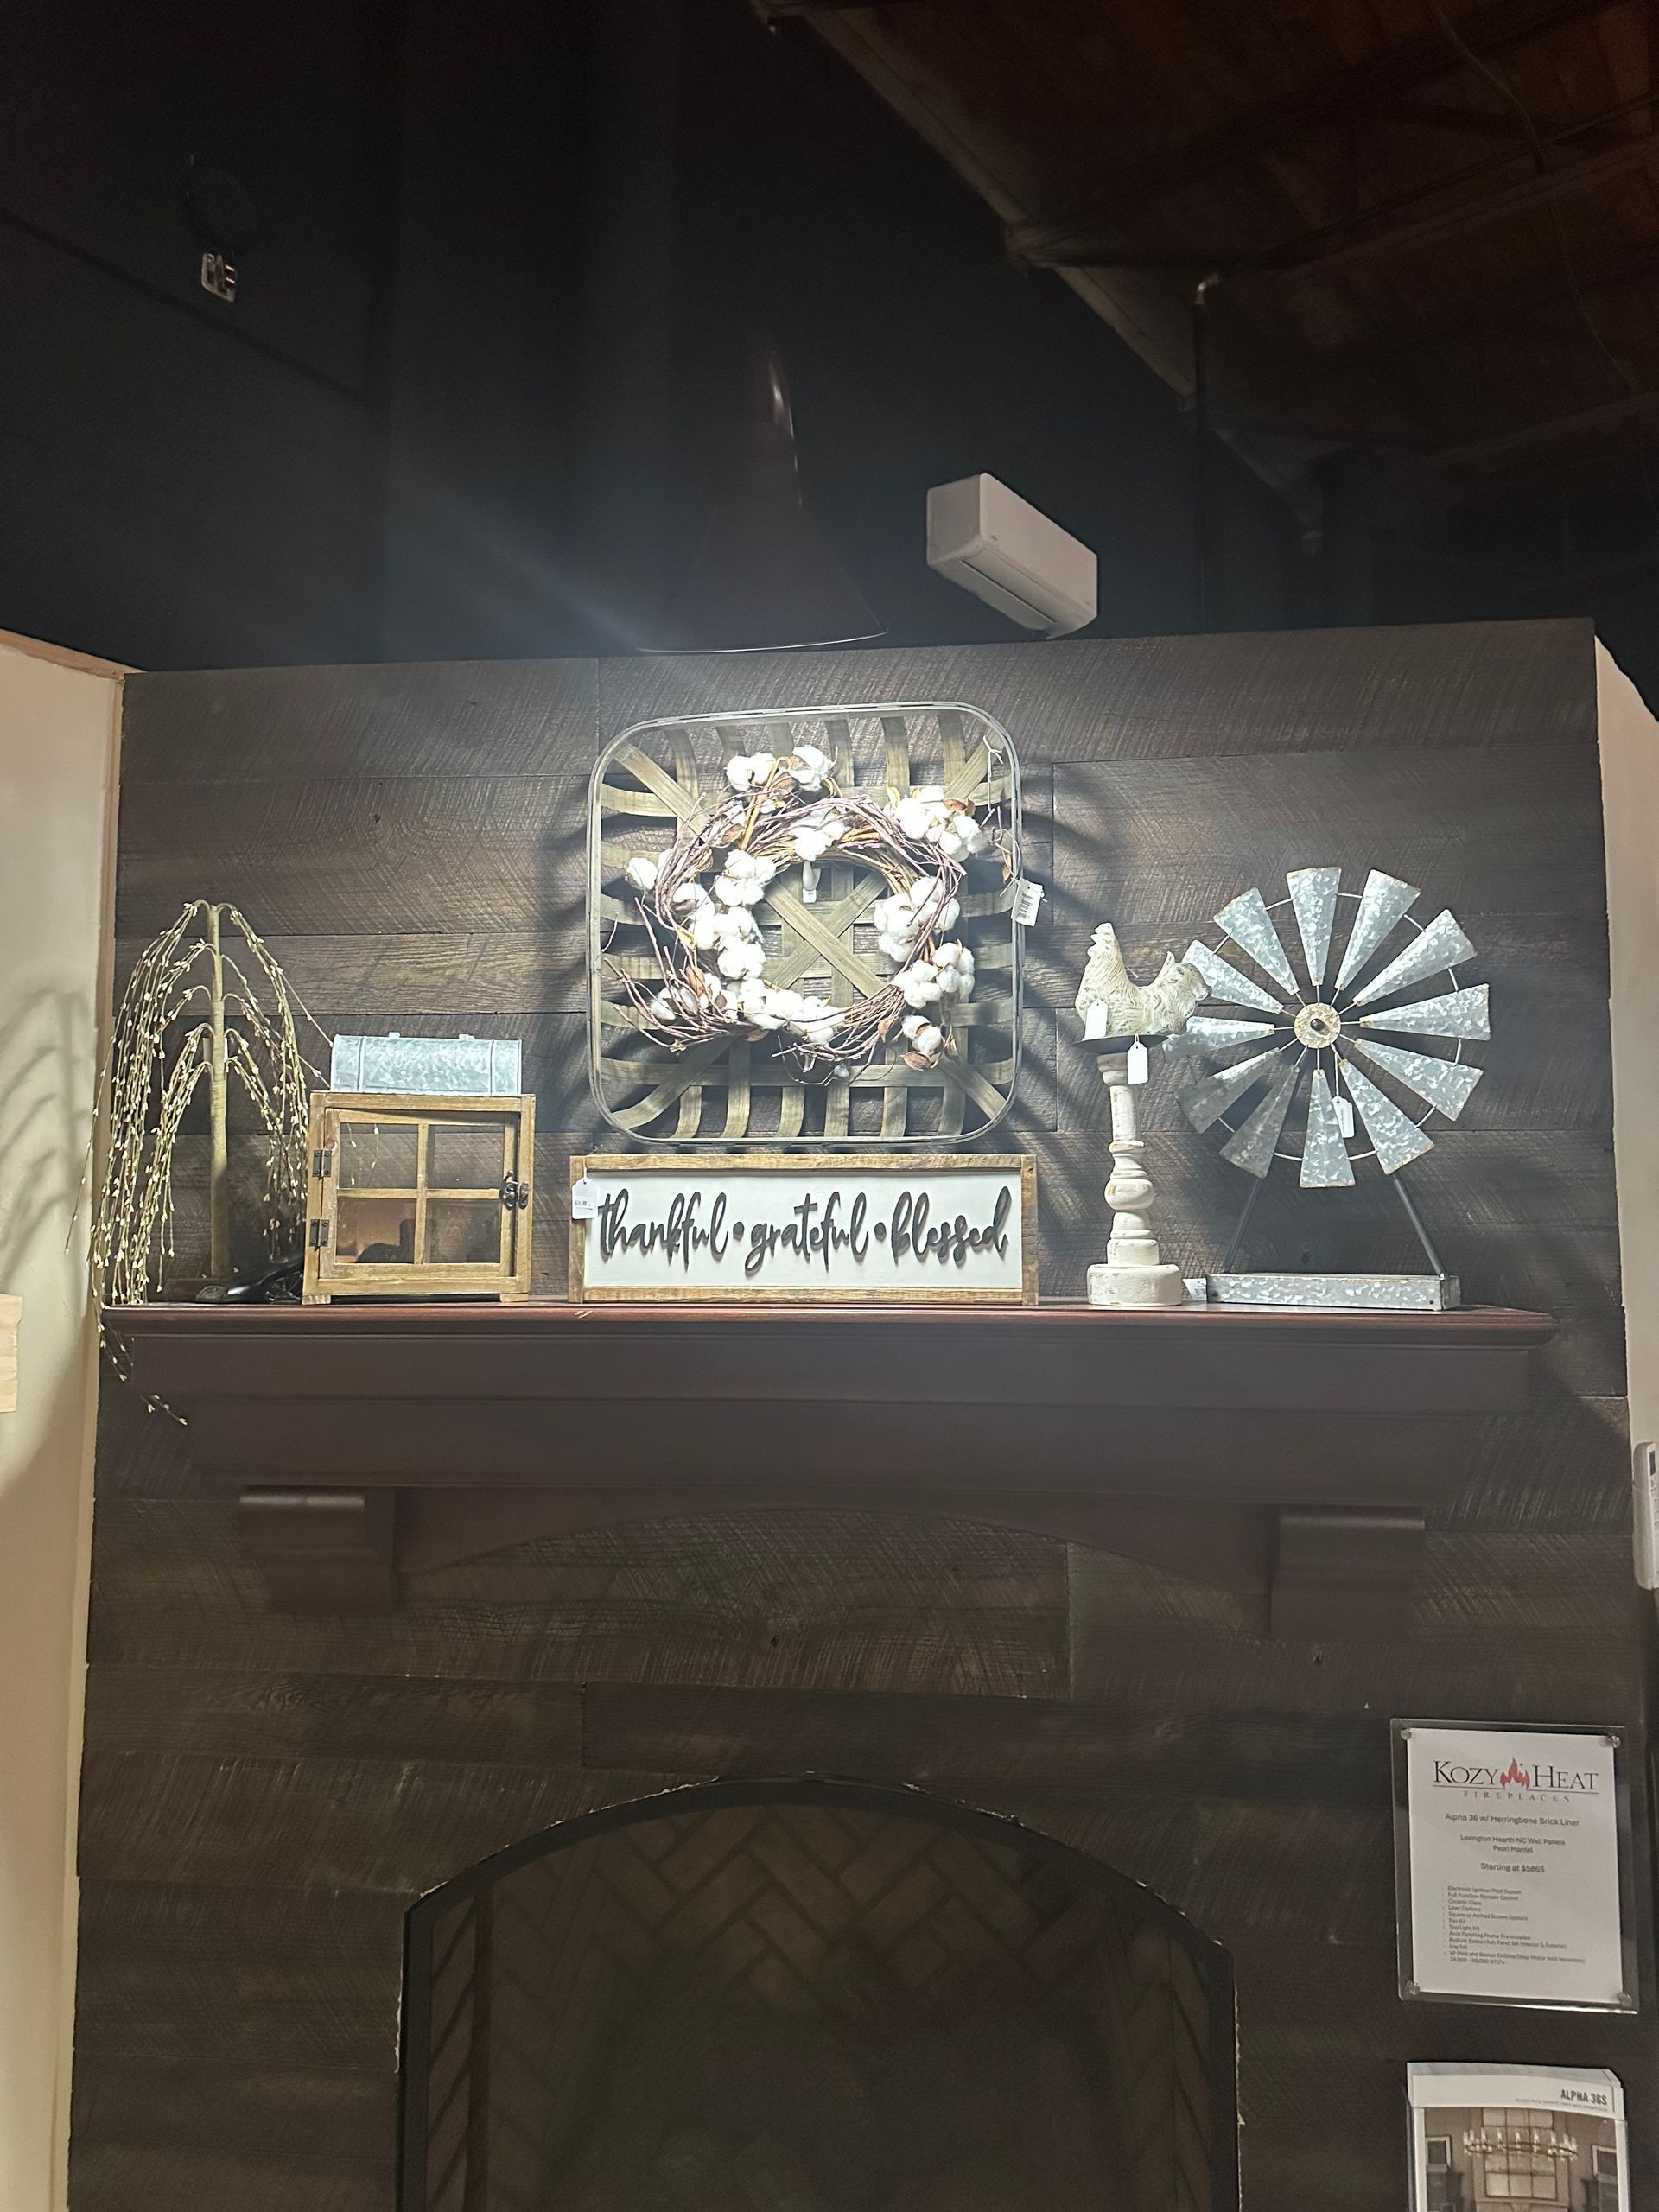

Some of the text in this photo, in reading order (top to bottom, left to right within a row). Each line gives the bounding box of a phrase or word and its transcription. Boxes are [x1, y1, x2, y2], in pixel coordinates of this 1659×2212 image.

[598, 1186, 1010, 1276] thankful grateful blessed
[1433, 1760, 1599, 1790] KOZY HEAT
[1464, 1789, 1570, 1802] FIREPLACES
[1445, 1813, 1467, 1821] Alpha
[1491, 1815, 1538, 1825] Herringbone
[1539, 1817, 1559, 1826] Brick
[1480, 1862, 1511, 1872] Starting
[1560, 2089, 1588, 2102] ALPHA
[1591, 2093, 1607, 2106] 36S
